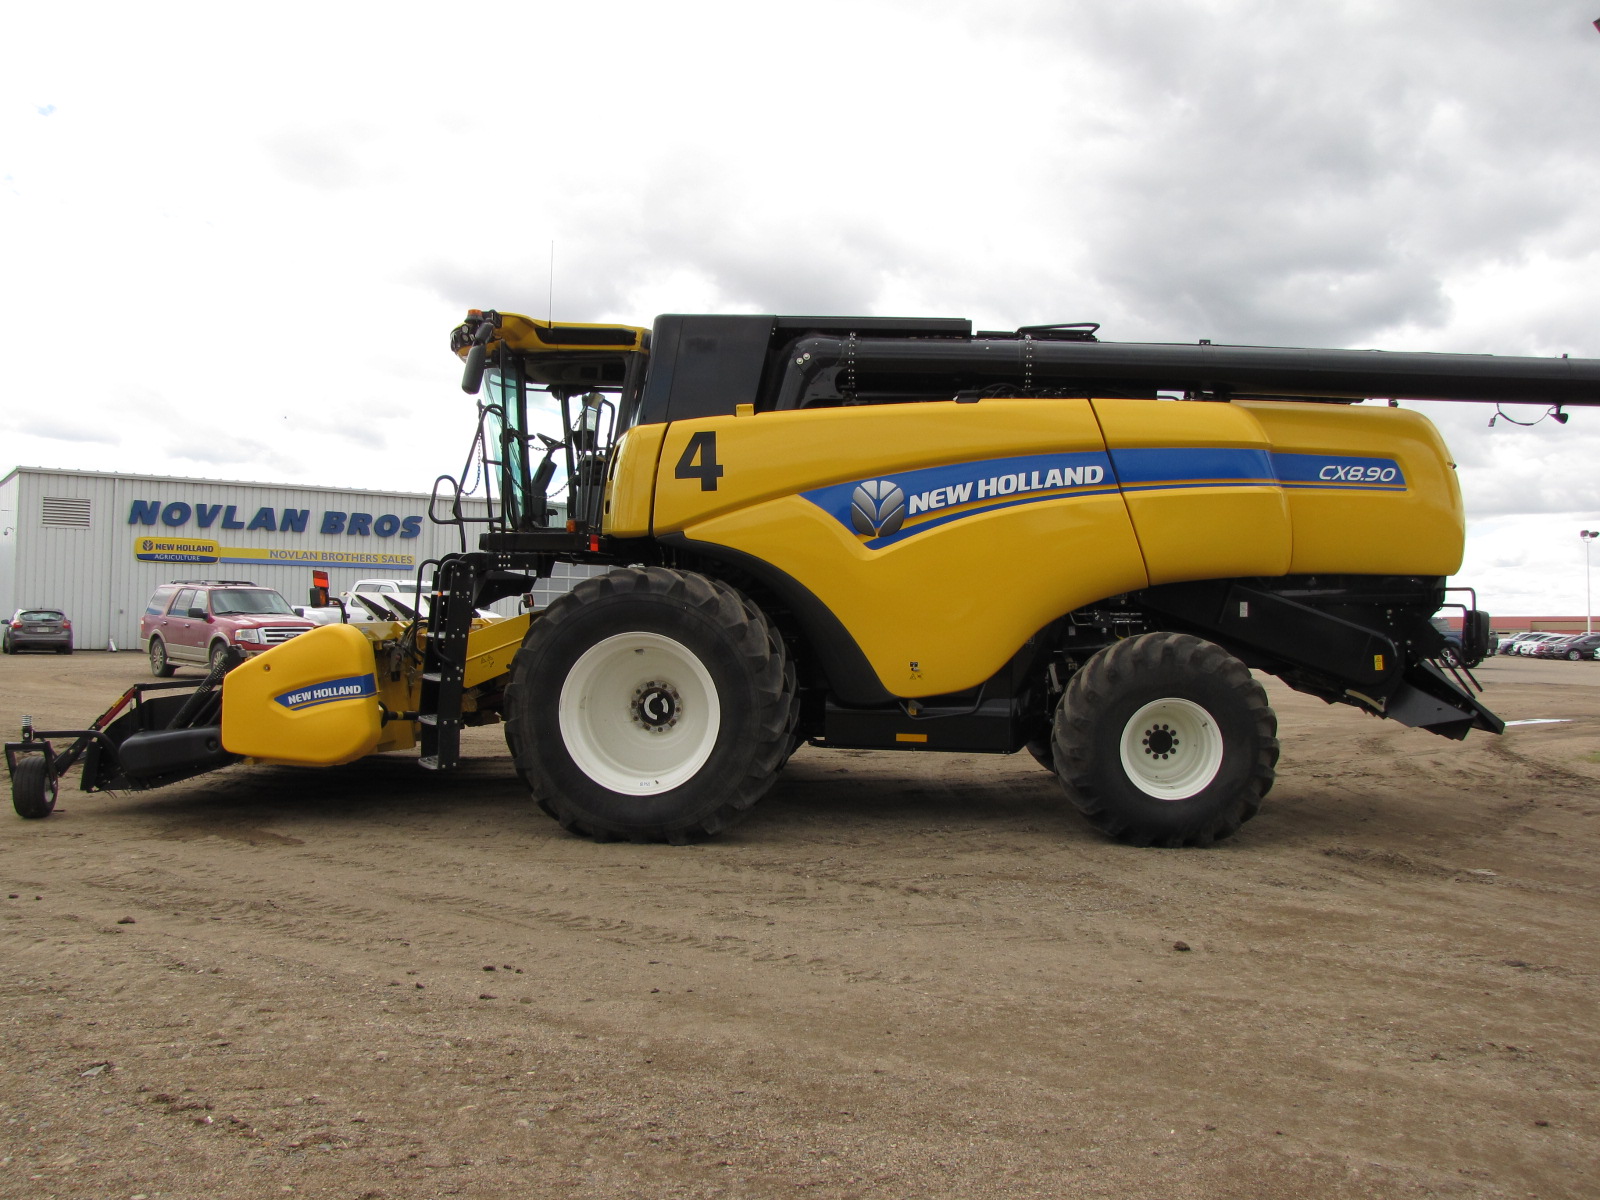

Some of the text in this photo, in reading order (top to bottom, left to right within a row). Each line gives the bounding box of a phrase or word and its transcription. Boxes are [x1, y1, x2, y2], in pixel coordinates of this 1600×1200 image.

[674, 430, 724, 492] 4
[1319, 465, 1396, 482] CX8.90
[908, 465, 1104, 515] NEW HOLLAND
[128, 499, 423, 539] NOVLAN BROS
[155, 543, 214, 553] NEW HOLLAND
[269, 550, 413, 564] NOVLAN BROTHERS SALES
[154, 554, 201, 562] AGRICULTURE
[287, 685, 362, 705] NEW HOLLAND
